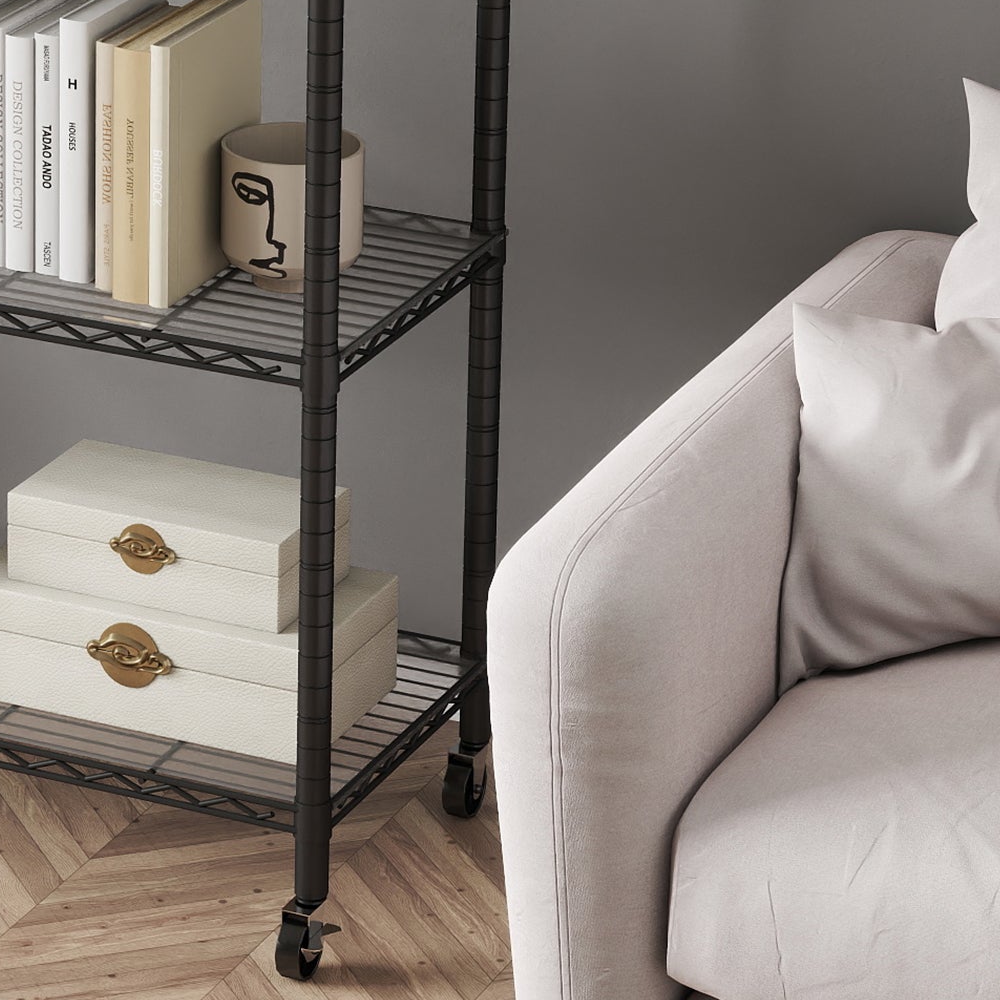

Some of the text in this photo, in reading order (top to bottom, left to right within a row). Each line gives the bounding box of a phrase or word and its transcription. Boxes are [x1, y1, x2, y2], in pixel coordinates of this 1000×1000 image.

[12, 80, 23, 230] DESIGN COLLECTION
[42, 125, 52, 189] TADAO ANDO
[68, 122, 77, 151] HOUSES
[43, 241, 52, 268] TASCEN
